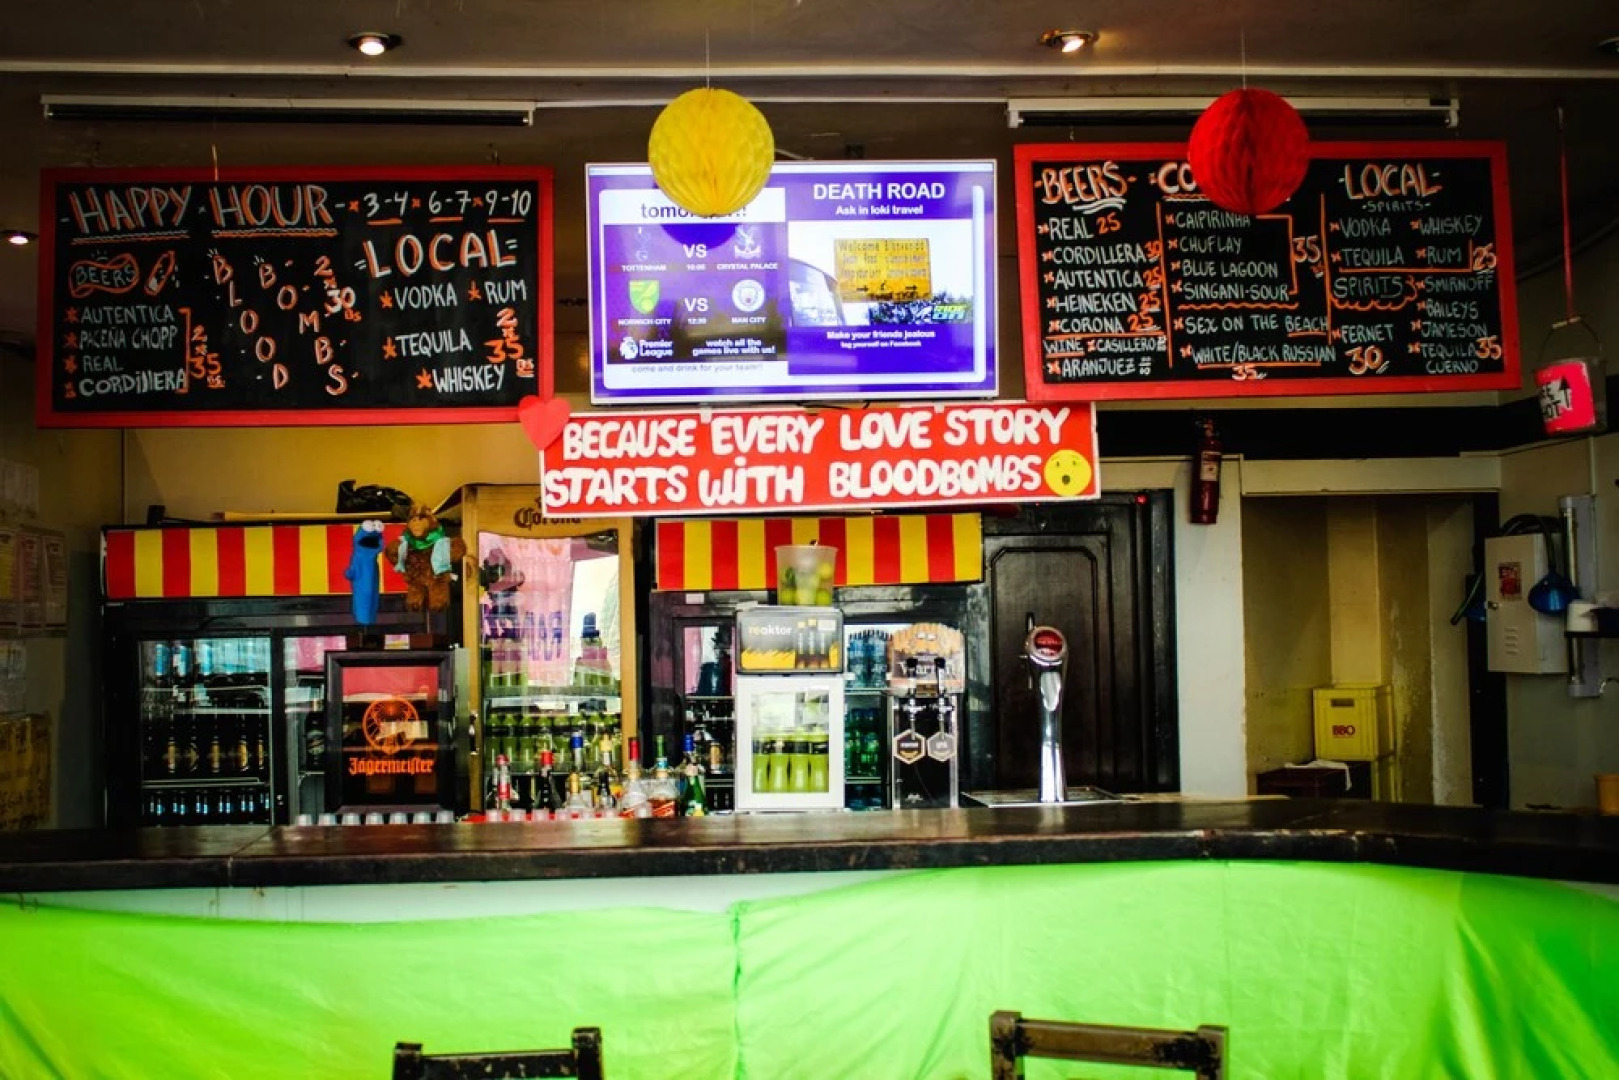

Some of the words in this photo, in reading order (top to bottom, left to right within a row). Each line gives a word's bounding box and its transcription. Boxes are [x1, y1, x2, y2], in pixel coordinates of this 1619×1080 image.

[1041, 161, 1128, 204] BEERS
[1344, 163, 1443, 199] LOCAL
[813, 183, 882, 199] DEATH
[887, 183, 945, 199] ROAD
[69, 185, 192, 234] HAPPY
[209, 184, 334, 228] HOUR
[364, 190, 408, 218] 3-4
[429, 190, 471, 215] 6-7
[485, 189, 531, 216] 9-10
[835, 206, 856, 215] Ask
[858, 206, 868, 215] in
[871, 206, 890, 215] loki
[892, 205, 923, 215] travel
[1367, 200, 1424, 213] SPIRITS
[1049, 217, 1094, 240] REAL
[1096, 212, 1122, 234] 25
[1176, 210, 1250, 229] CAIPIRINHA
[1339, 217, 1392, 238] VODKA
[1420, 214, 1484, 237] WHISKEY
[363, 229, 517, 278] LOCAL
[683, 244, 707, 258] VS
[1053, 242, 1147, 265] CORDILLERA
[1180, 235, 1242, 254] CHUFLAY
[1293, 235, 1321, 263] 35
[1341, 246, 1405, 266] TEQUILA
[1427, 247, 1462, 264] RUM
[75, 266, 136, 286] BEERS
[622, 264, 667, 272] TOTTENHAM
[1182, 259, 1216, 277] BLUE
[1221, 261, 1278, 278] LAGOON
[1053, 269, 1144, 291] AUTENTICA
[1333, 276, 1403, 299] SPIRITS
[1425, 274, 1493, 292] SMIRNOFF
[394, 282, 458, 310] VODKA
[484, 279, 528, 304] RUM
[1184, 282, 1289, 301] SINGANI-SOUR
[684, 297, 709, 312] VS
[1057, 292, 1138, 314] HEINEKEN
[1426, 300, 1479, 319] BAILEYS
[81, 304, 175, 325] AUTENTICA
[655, 318, 672, 326] CITY
[1185, 316, 1218, 334] SEX
[1222, 315, 1244, 332] ON
[1250, 314, 1279, 330] THE
[1285, 315, 1329, 332] BEACH
[1059, 316, 1125, 334] CORONA
[1341, 324, 1394, 343] FERNET
[1421, 322, 1487, 338] JAMESON
[132, 325, 178, 350] CHOPP
[395, 328, 472, 358] TEQUILA
[639, 339, 673, 348] Premier
[706, 338, 733, 347] watch
[735, 338, 746, 347] all
[748, 338, 762, 347] the
[827, 331, 850, 339] Make
[851, 332, 871, 340] your
[904, 330, 936, 339] jealous
[639, 348, 674, 359] League
[692, 348, 723, 357] games
[724, 346, 739, 354] live
[740, 346, 760, 354] with
[1043, 338, 1084, 353] WINE
[1096, 338, 1157, 353] CASILLERO
[1192, 340, 1279, 364] WHITE/BLACK
[1282, 344, 1336, 362] RUSSIAN
[1420, 343, 1476, 359] TEQUILA
[83, 355, 123, 372] REAL
[632, 365, 656, 373] come
[658, 364, 674, 372] and
[676, 363, 697, 371] drink
[700, 363, 712, 371] for
[714, 365, 733, 373] your
[1062, 357, 1136, 378] ARANJUEZ
[1425, 361, 1479, 374] CUERVO
[432, 364, 506, 393] WHISKEY
[563, 418, 697, 461] BECAUSE
[711, 414, 824, 455] EVERY
[840, 411, 932, 451] LOVE
[944, 407, 1070, 446] STORY
[544, 465, 689, 508] STARTS
[829, 454, 1042, 499] BLOODBOMBS
